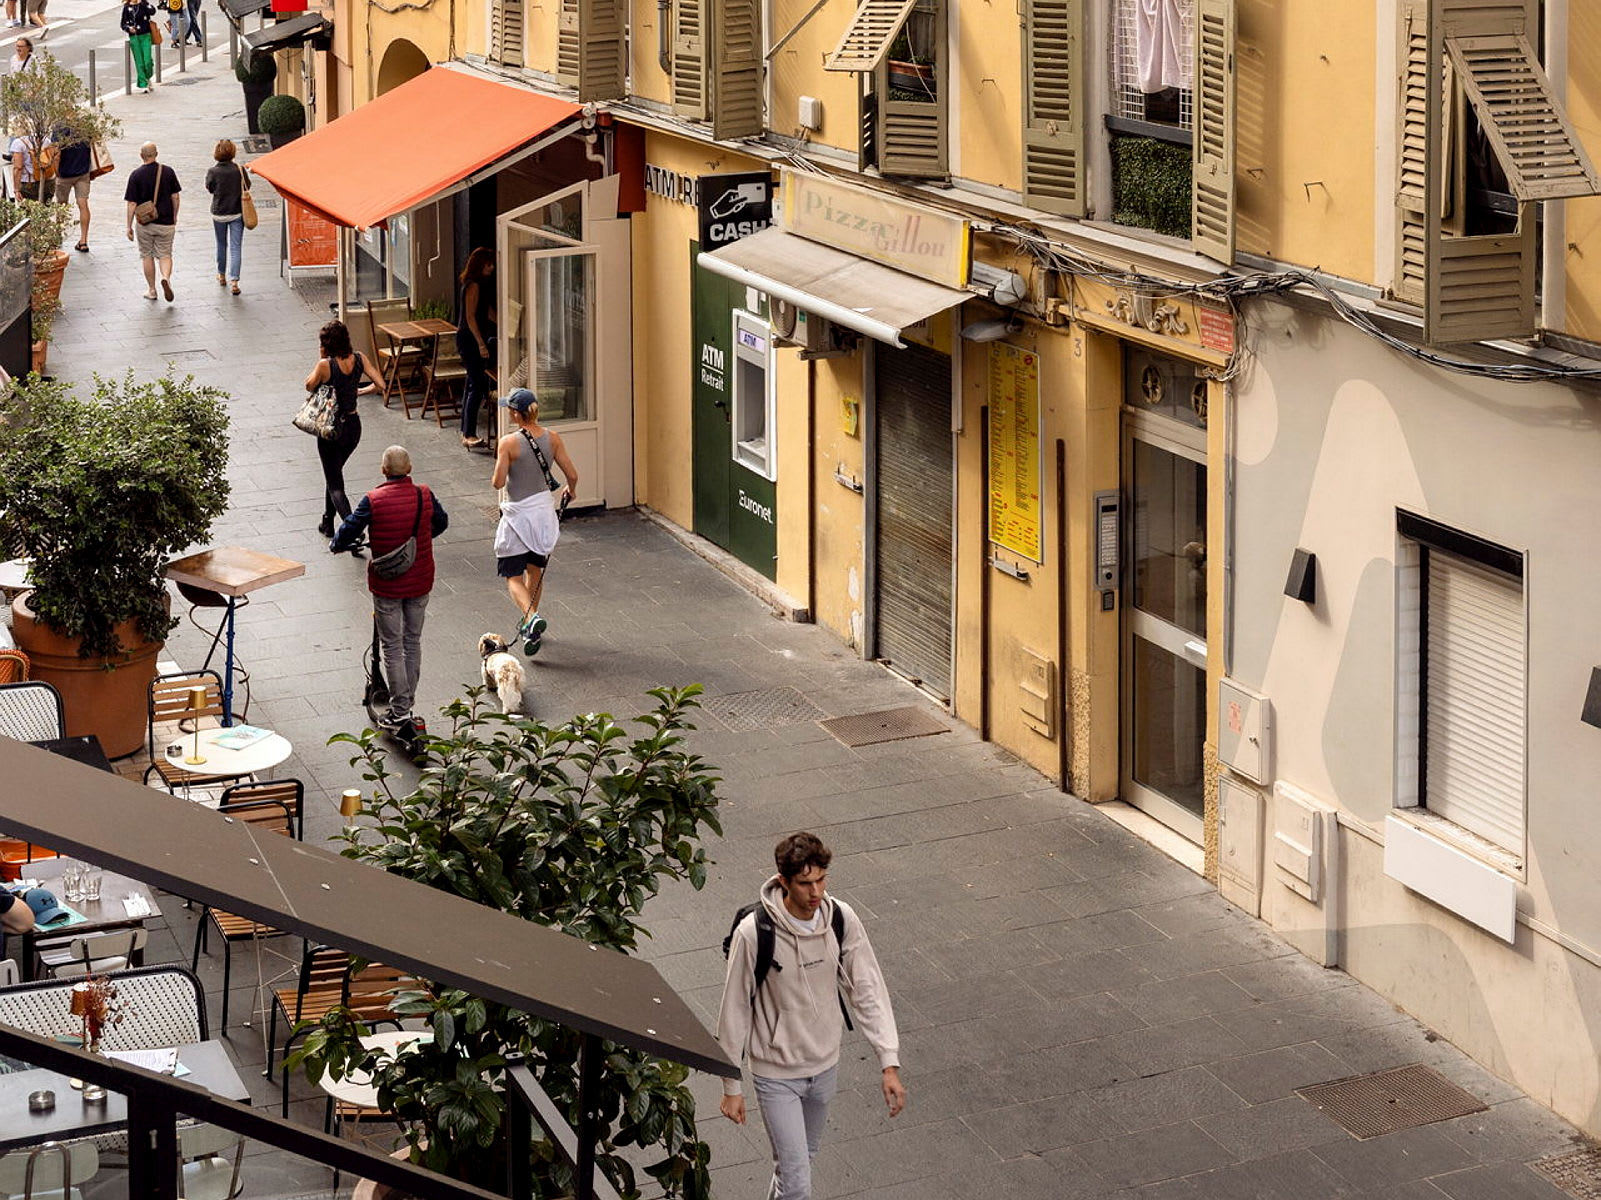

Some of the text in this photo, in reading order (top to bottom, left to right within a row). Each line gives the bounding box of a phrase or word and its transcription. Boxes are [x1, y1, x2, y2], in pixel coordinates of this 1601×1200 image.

[645, 164, 677, 199] ATM
[806, 190, 888, 238] Pizza
[876, 215, 945, 257] Gillou
[744, 333, 757, 347] ATM
[1074, 337, 1082, 357] 3
[702, 343, 724, 370] ATM
[701, 368, 724, 392] Retrait
[739, 489, 773, 525] Euronet
